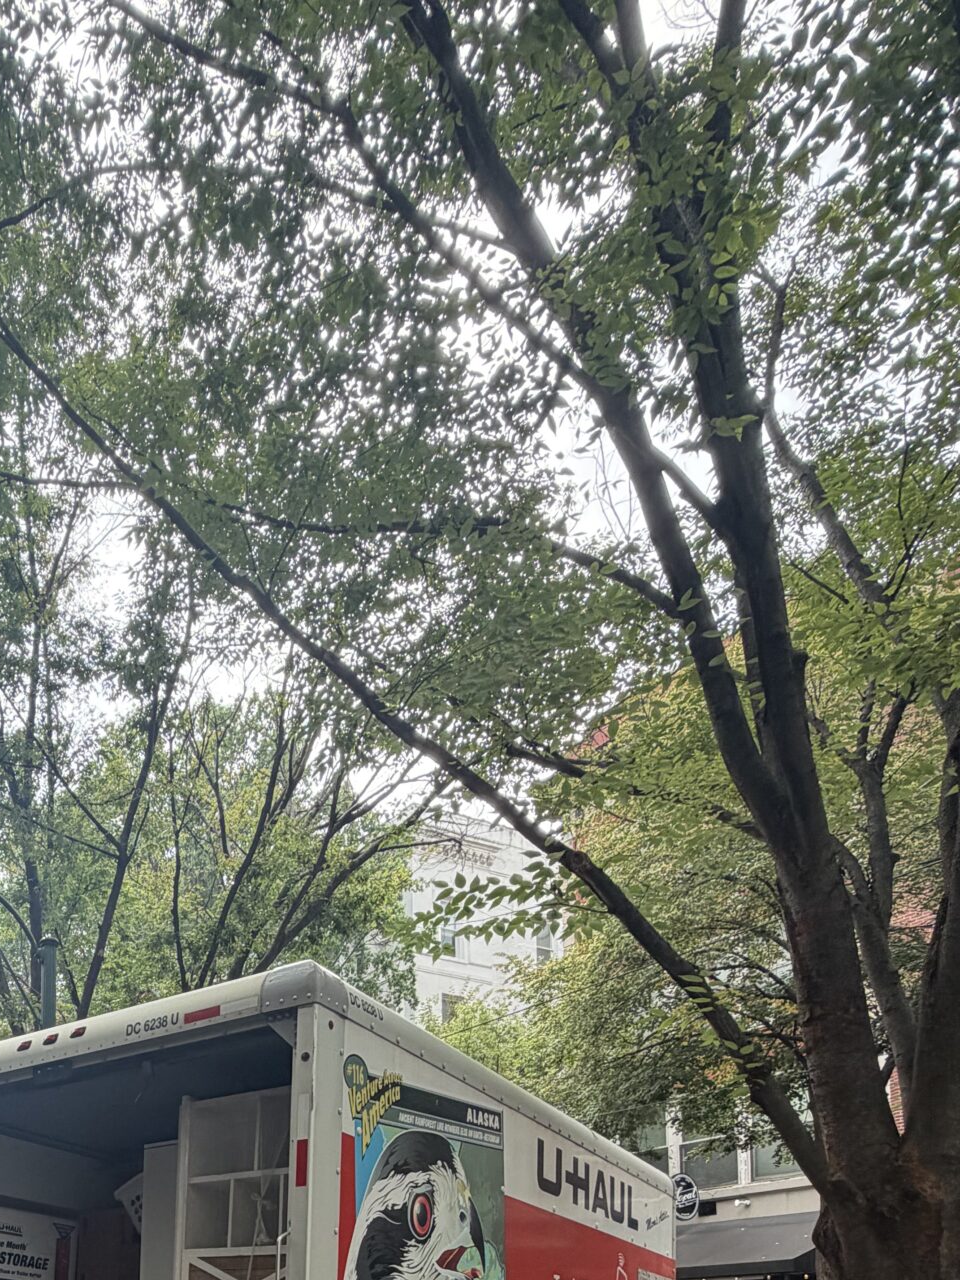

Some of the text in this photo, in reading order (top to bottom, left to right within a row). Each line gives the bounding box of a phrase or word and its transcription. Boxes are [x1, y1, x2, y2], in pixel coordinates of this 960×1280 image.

[349, 992, 361, 1008] DC
[377, 1007, 384, 1021] U
[126, 1012, 179, 1036] DC 6238 U
[346, 1063, 364, 1086] #116
[348, 1078, 383, 1120] Venture
[361, 1084, 401, 1160] America
[466, 1107, 500, 1130] ALASKA
[537, 1137, 639, 1231] U-HAUL
[6, 1241, 26, 1251] Month
